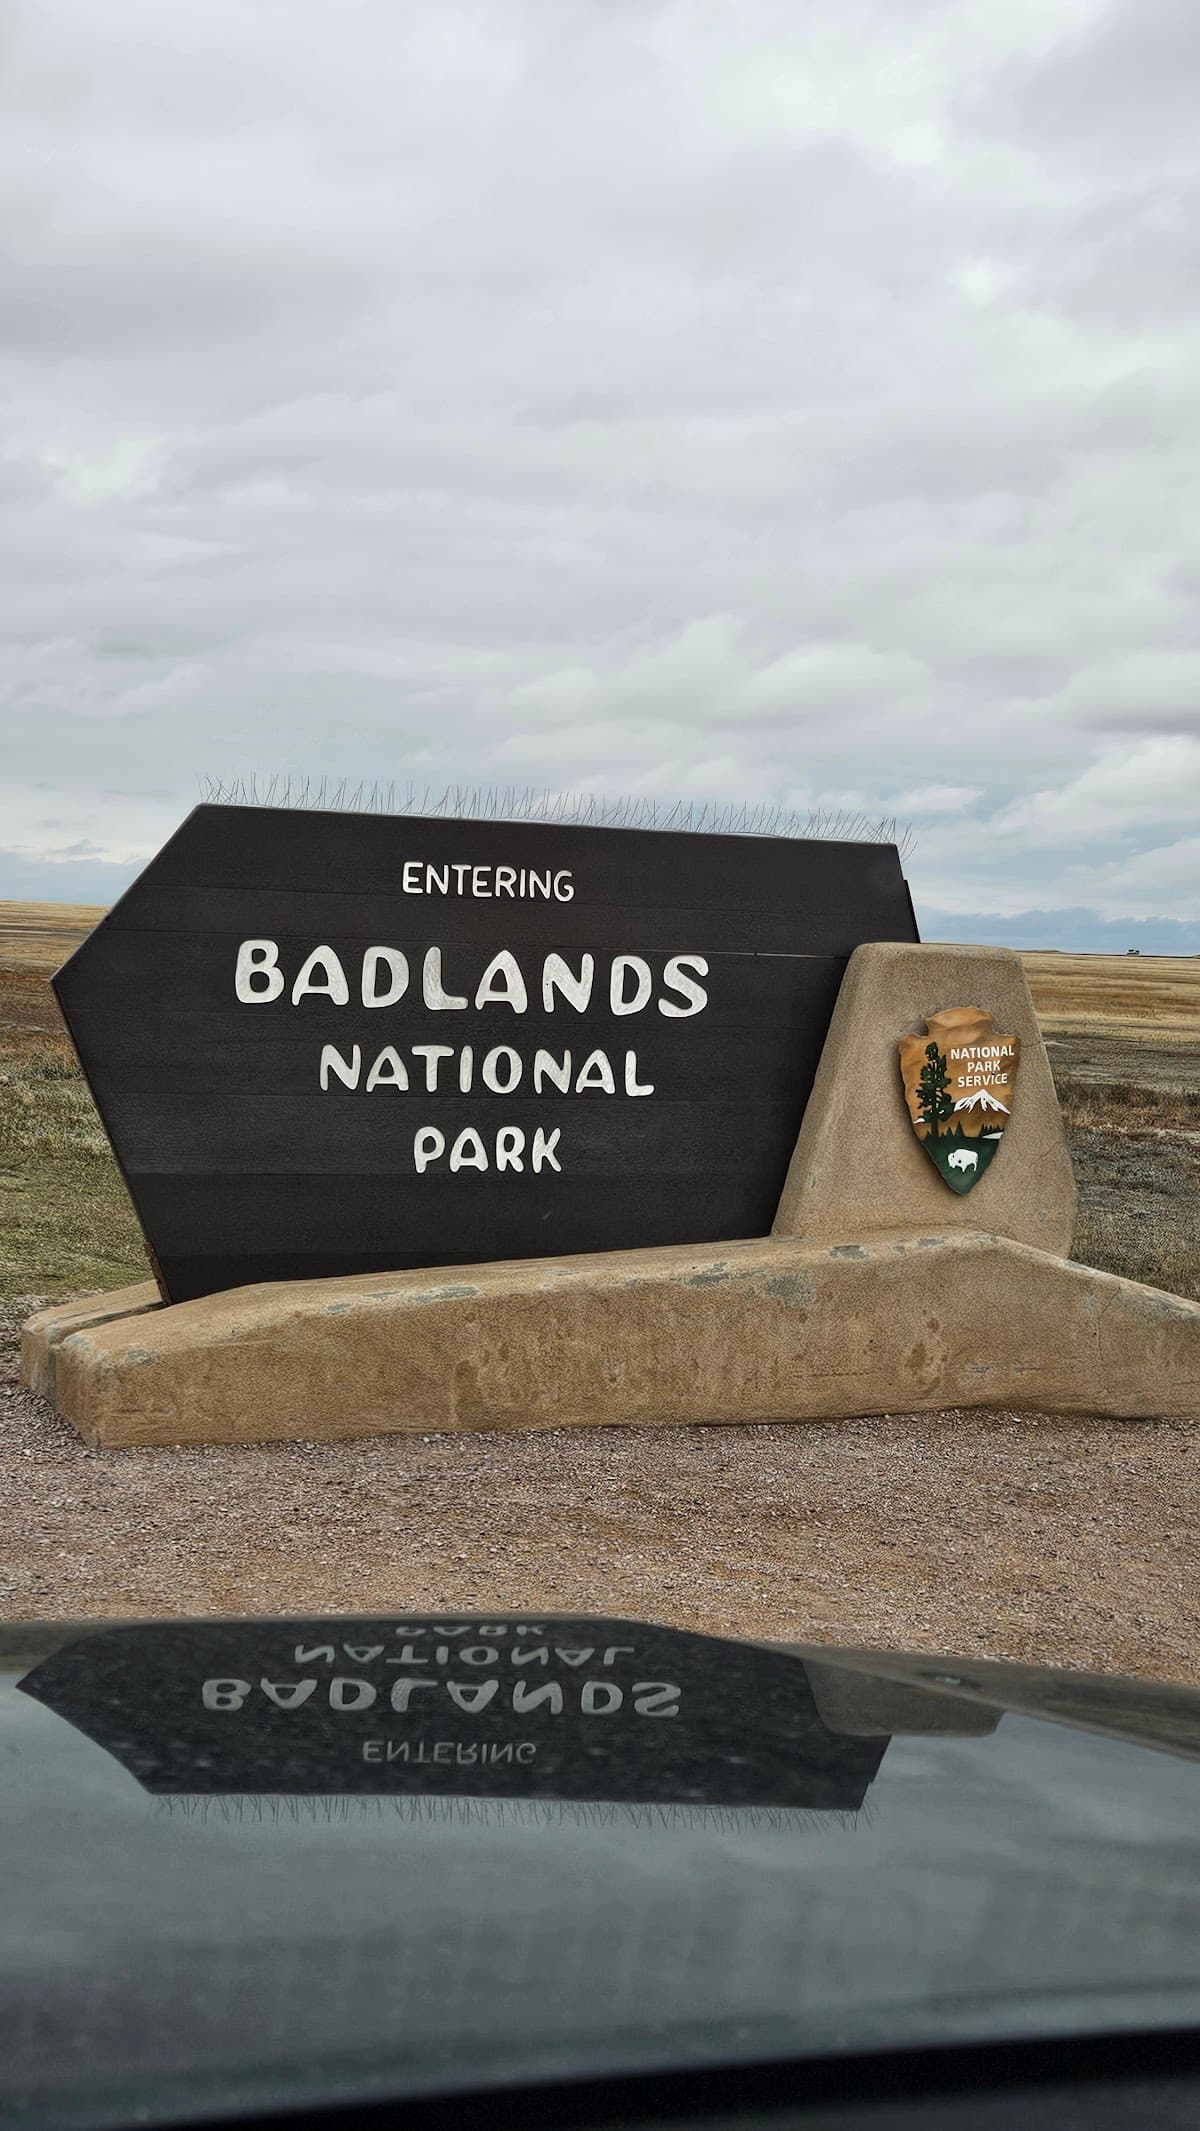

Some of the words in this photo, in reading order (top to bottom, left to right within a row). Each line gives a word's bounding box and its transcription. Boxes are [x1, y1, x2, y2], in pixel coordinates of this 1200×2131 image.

[402, 861, 575, 902] ENTERING
[235, 939, 708, 1018] BADLANDS
[319, 1044, 655, 1097] NATIONAL
[950, 1045, 1015, 1060] NATIONAL
[967, 1059, 1001, 1073] PARK
[957, 1072, 1008, 1088] SERVICE
[413, 1126, 562, 1174] PARK
